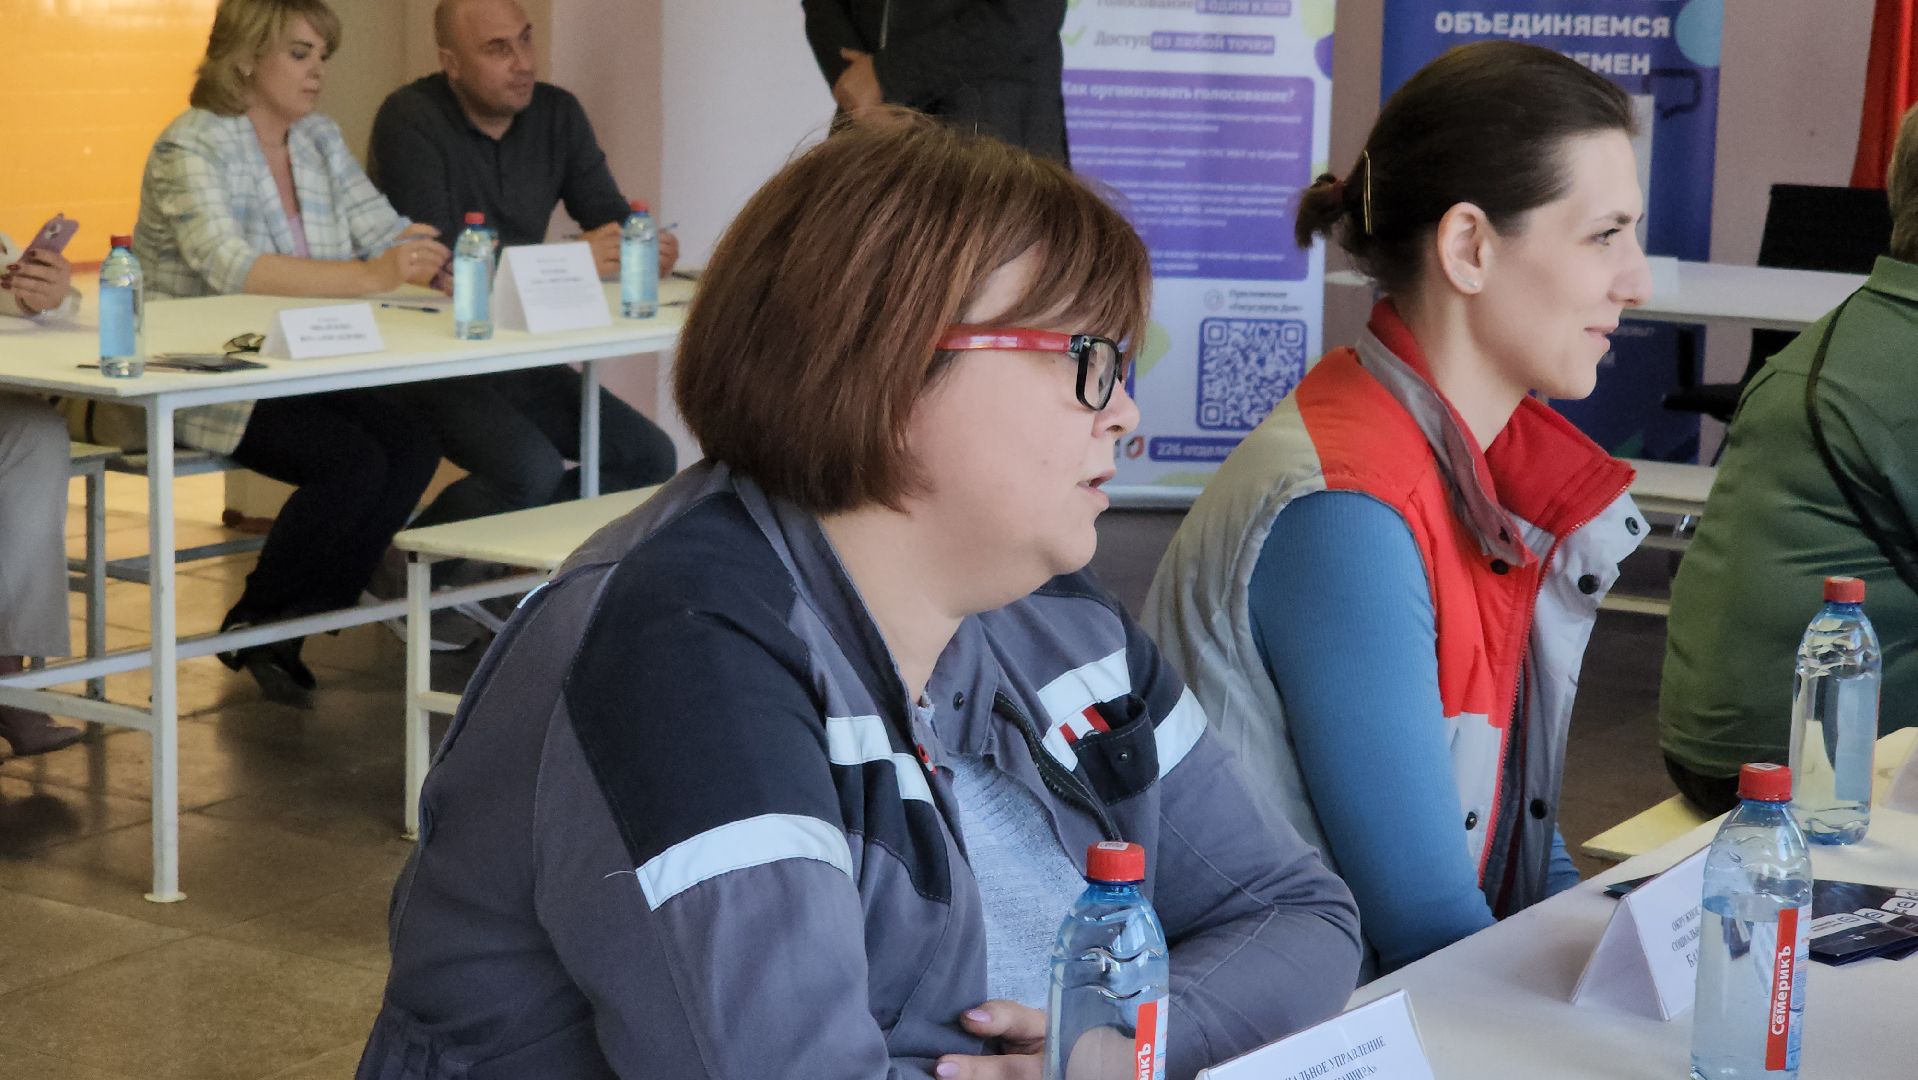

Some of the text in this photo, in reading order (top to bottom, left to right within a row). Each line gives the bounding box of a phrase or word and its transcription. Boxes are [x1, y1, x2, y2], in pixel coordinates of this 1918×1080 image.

[1434, 11, 1672, 38] ОБЪЕДИНЯЕМСЯ
[1561, 51, 1650, 75] ЕМЕН
[1091, 84, 1191, 101] организовать
[1329, 1035, 1387, 1069] УПРАВЛЕНИЕ
